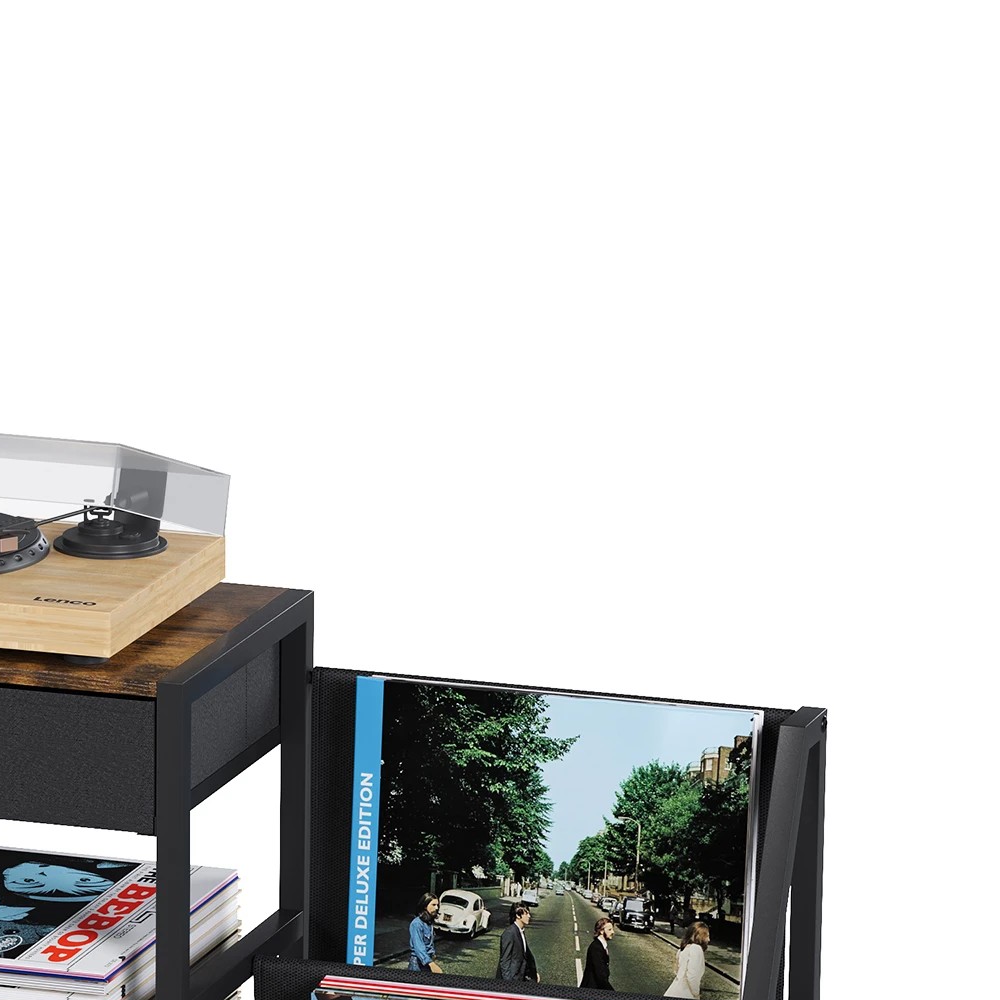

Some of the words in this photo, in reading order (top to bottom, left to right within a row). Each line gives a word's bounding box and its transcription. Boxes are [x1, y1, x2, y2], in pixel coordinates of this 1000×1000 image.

[33, 596, 97, 606] Lenco
[358, 772, 374, 850] EDITION
[137, 868, 157, 883] HE
[355, 855, 370, 930] DELUXE
[41, 883, 157, 963] BEBOP
